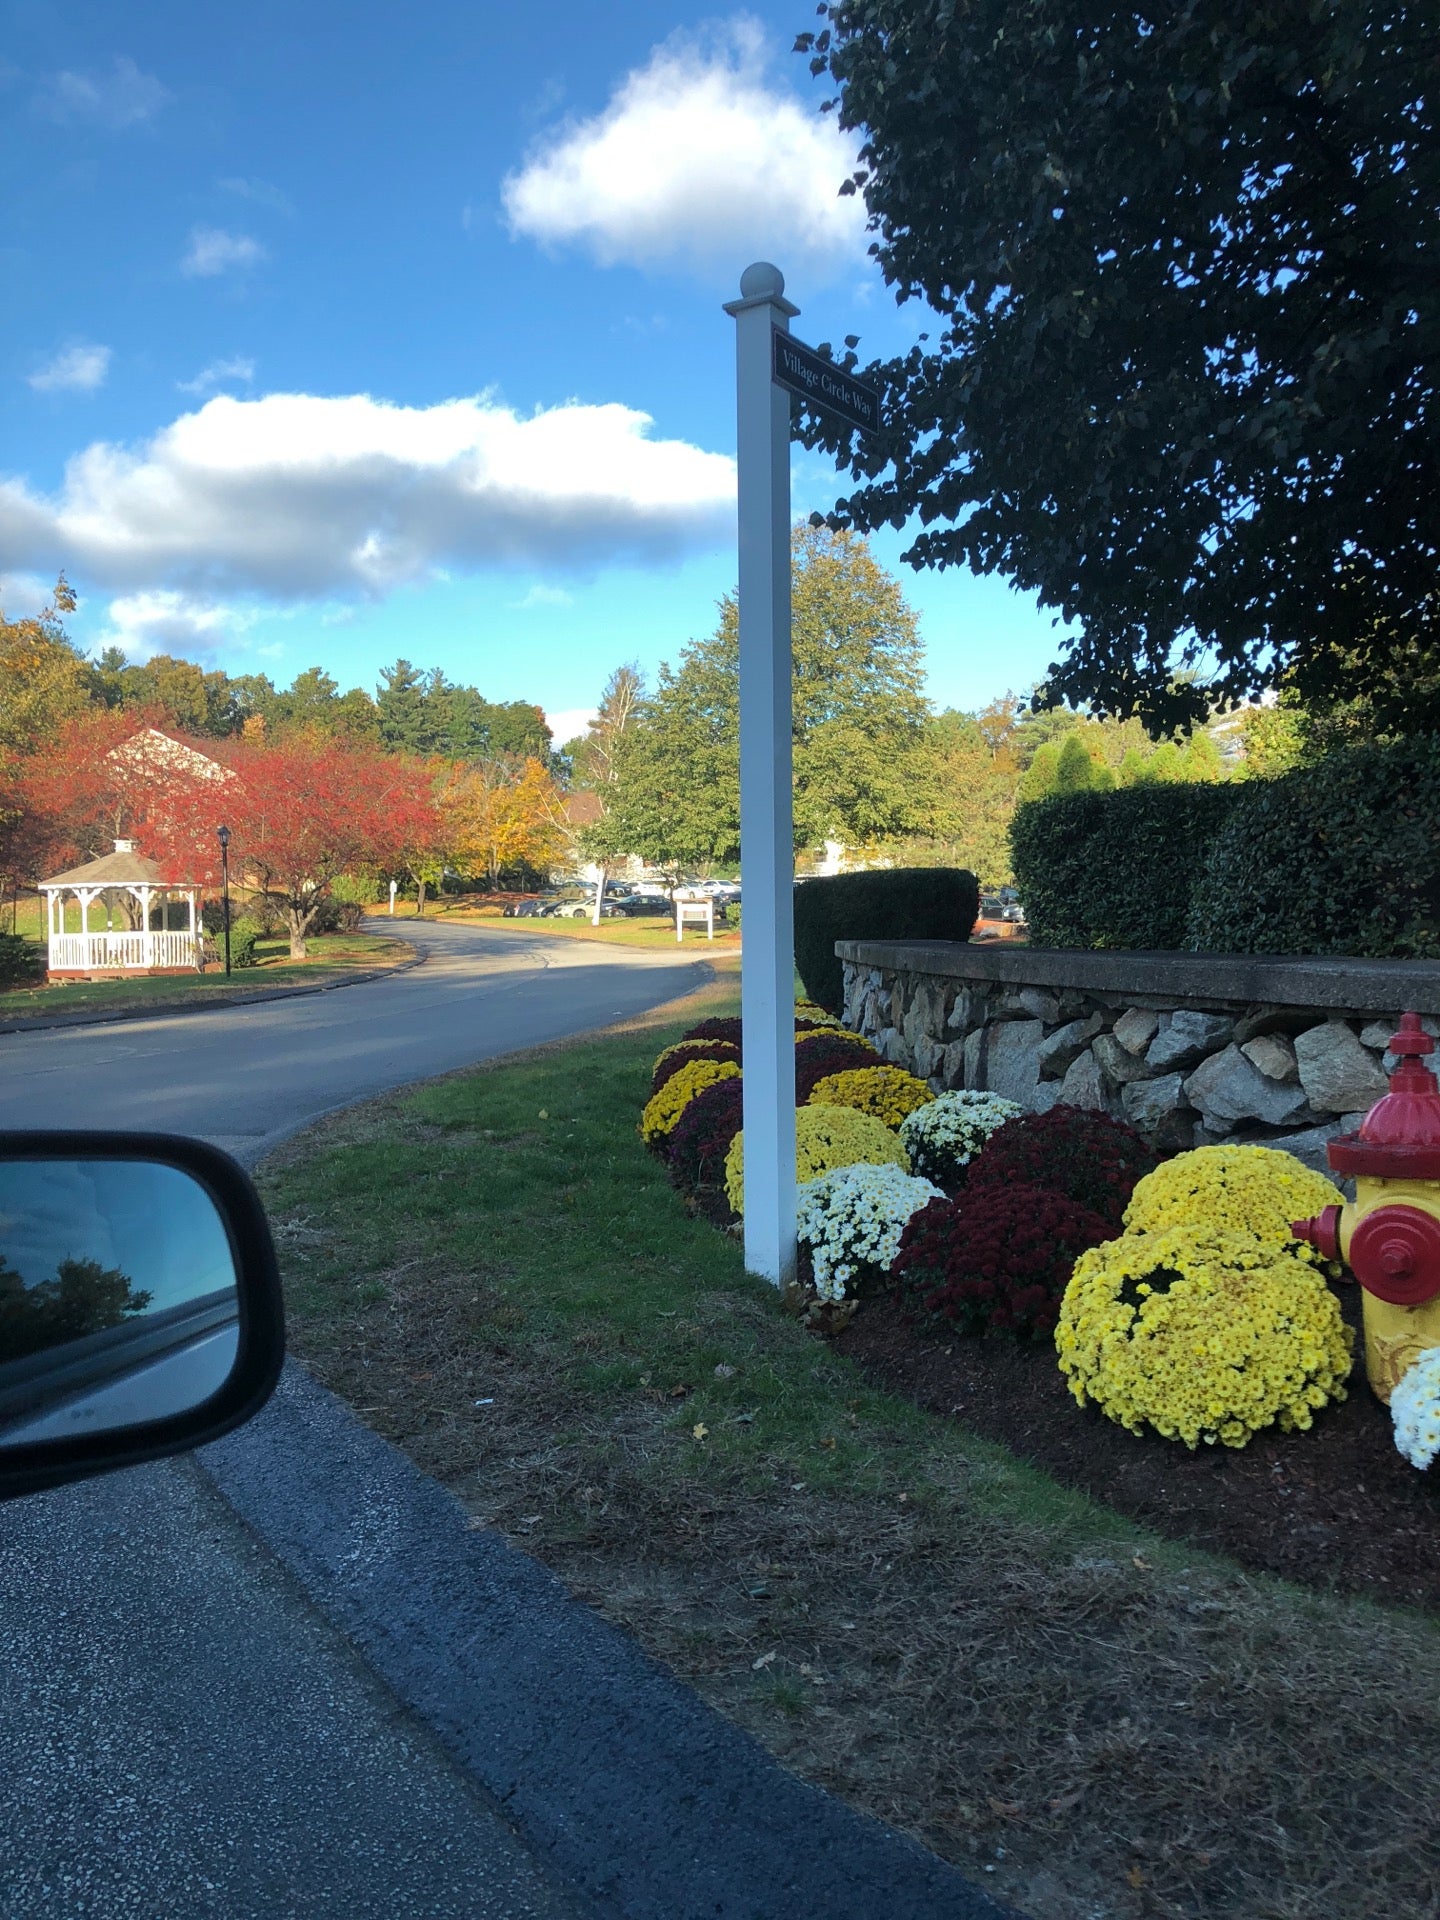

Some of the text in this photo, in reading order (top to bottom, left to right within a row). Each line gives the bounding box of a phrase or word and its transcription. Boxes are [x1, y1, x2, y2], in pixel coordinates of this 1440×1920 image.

[783, 349, 872, 420] Village Circle Way
